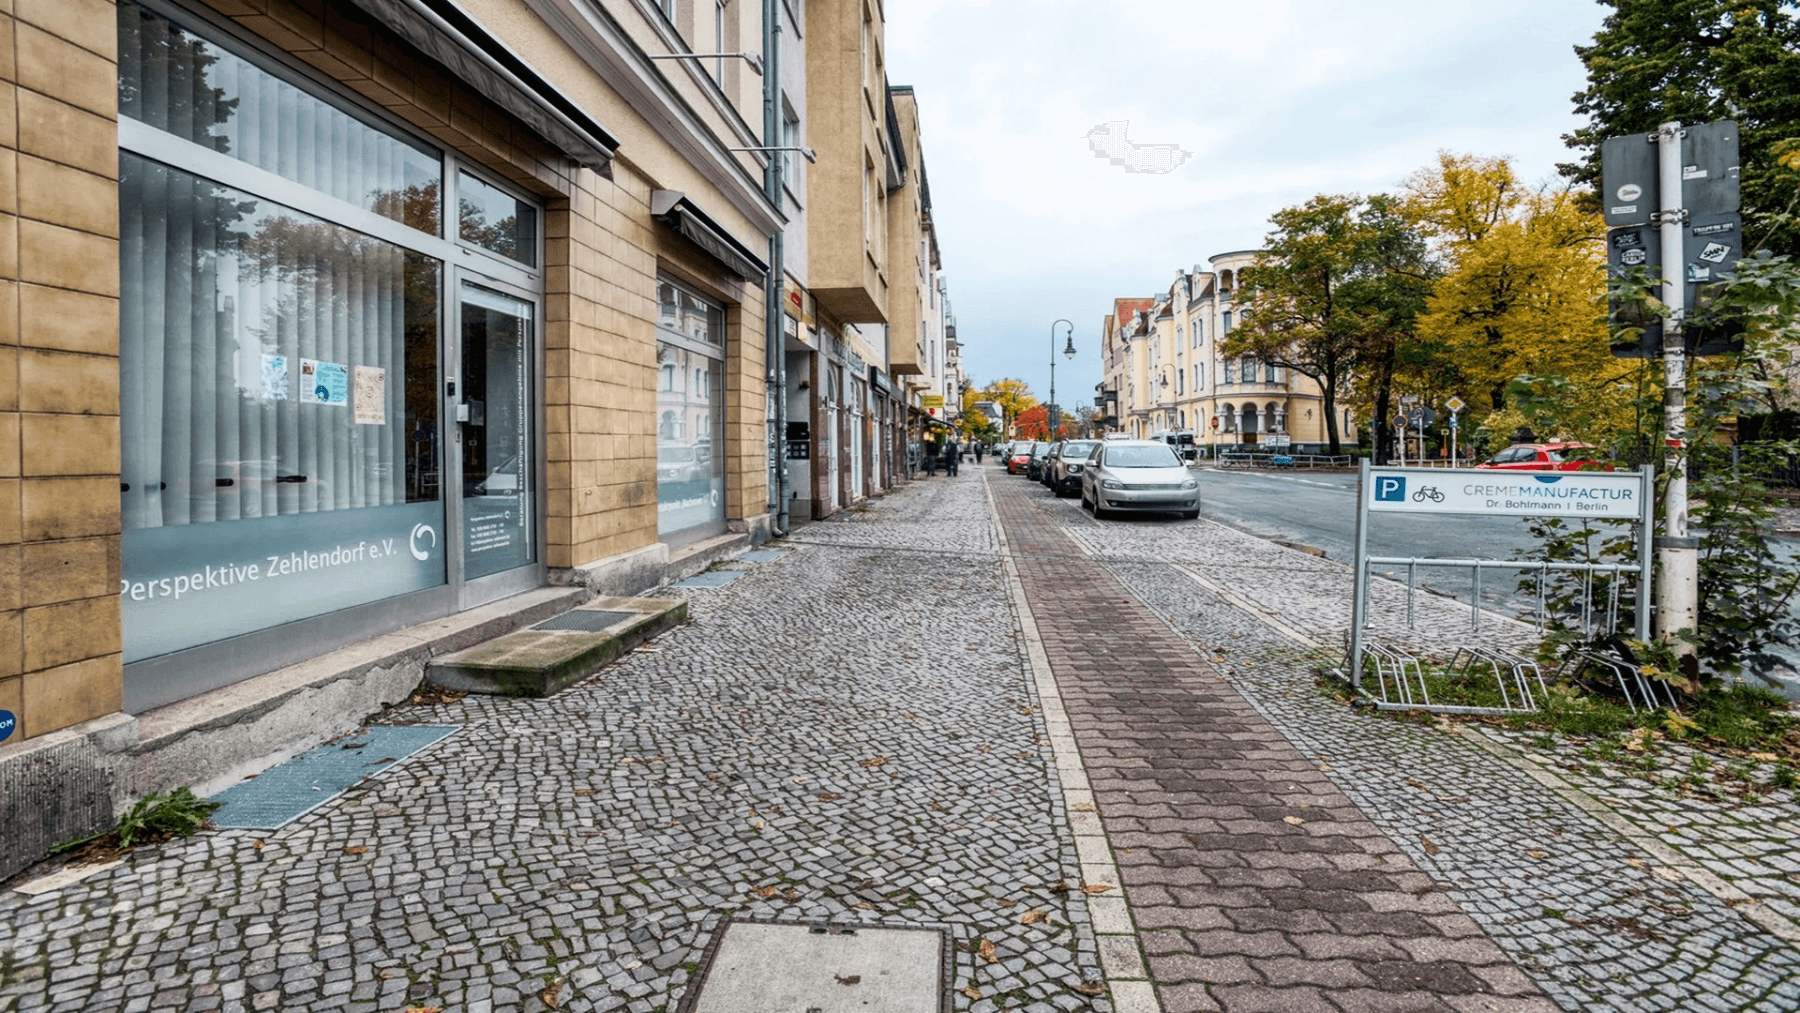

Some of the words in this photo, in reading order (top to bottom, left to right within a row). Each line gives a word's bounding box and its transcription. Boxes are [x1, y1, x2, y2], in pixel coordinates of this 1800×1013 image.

[1381, 479, 1400, 499] P
[1463, 484, 1633, 500] CREMEMANUFACTUR
[1505, 500, 1562, 510] Bohlmann
[1576, 502, 1608, 511] Berlin
[266, 541, 366, 577] Zehlendorf
[369, 538, 397, 559] e.V.
